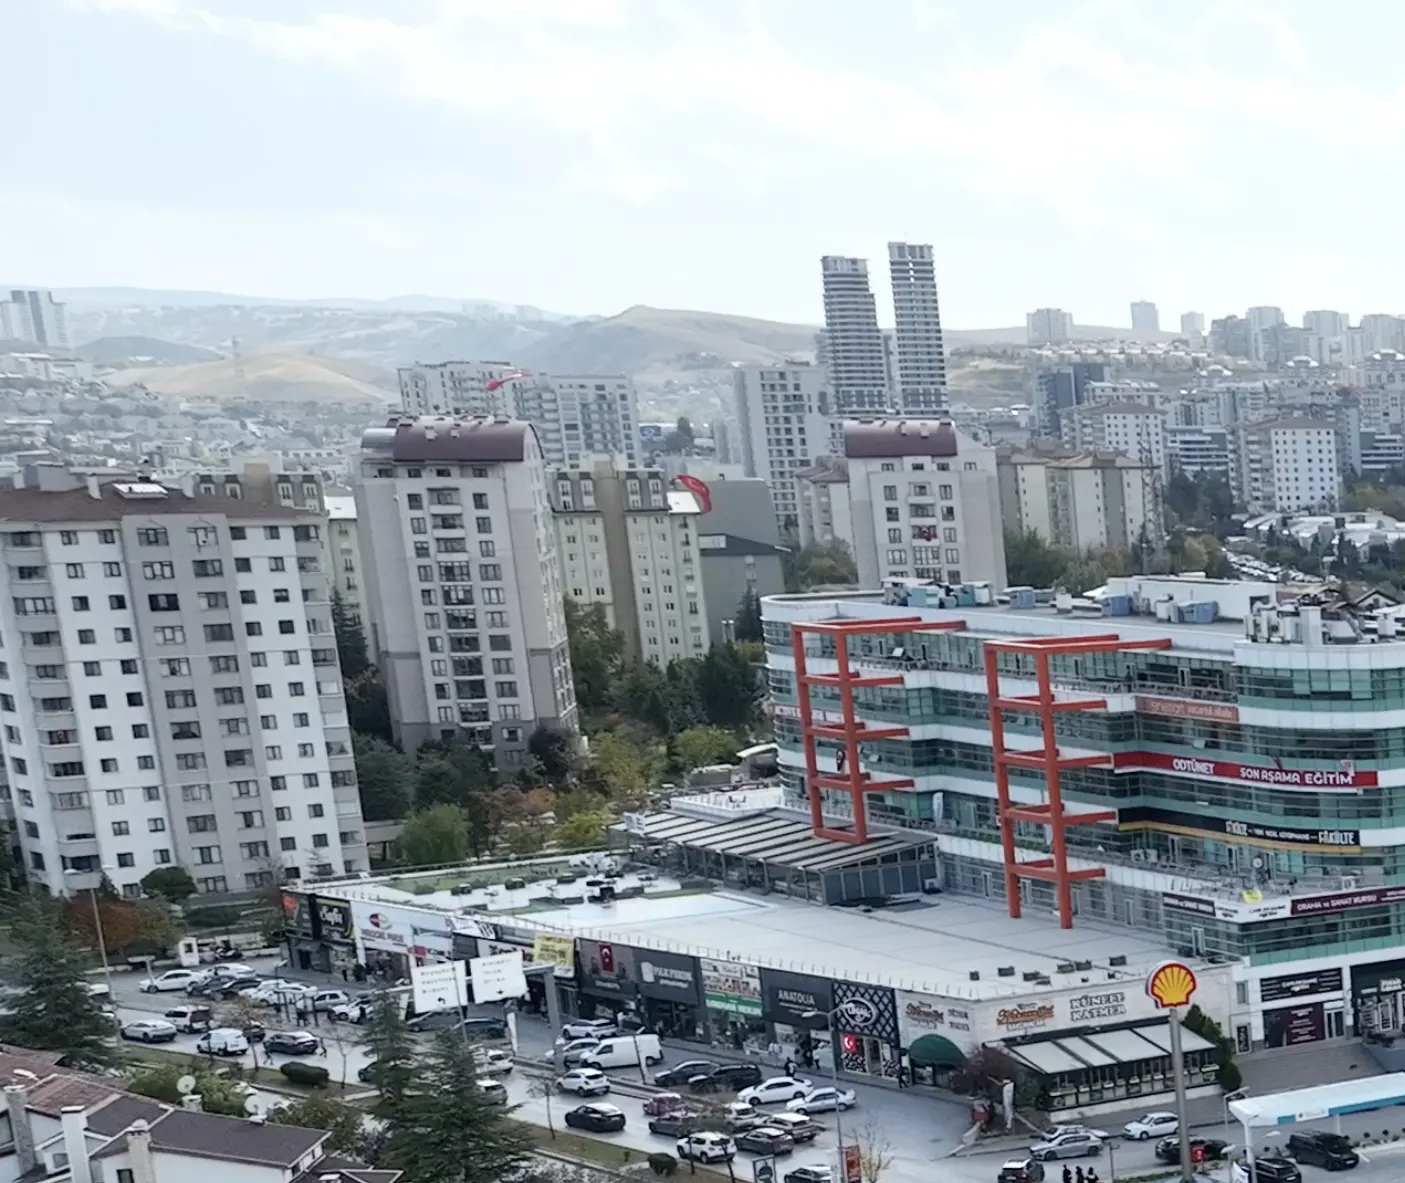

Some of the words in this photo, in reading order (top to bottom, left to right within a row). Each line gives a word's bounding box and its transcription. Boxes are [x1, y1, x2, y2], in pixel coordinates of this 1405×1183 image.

[1240, 767, 1260, 780] SON
[1261, 769, 1300, 784] AŞAMA
[1305, 770, 1353, 786] EĞİTİM
[1071, 1004, 1127, 1022] KATMER
